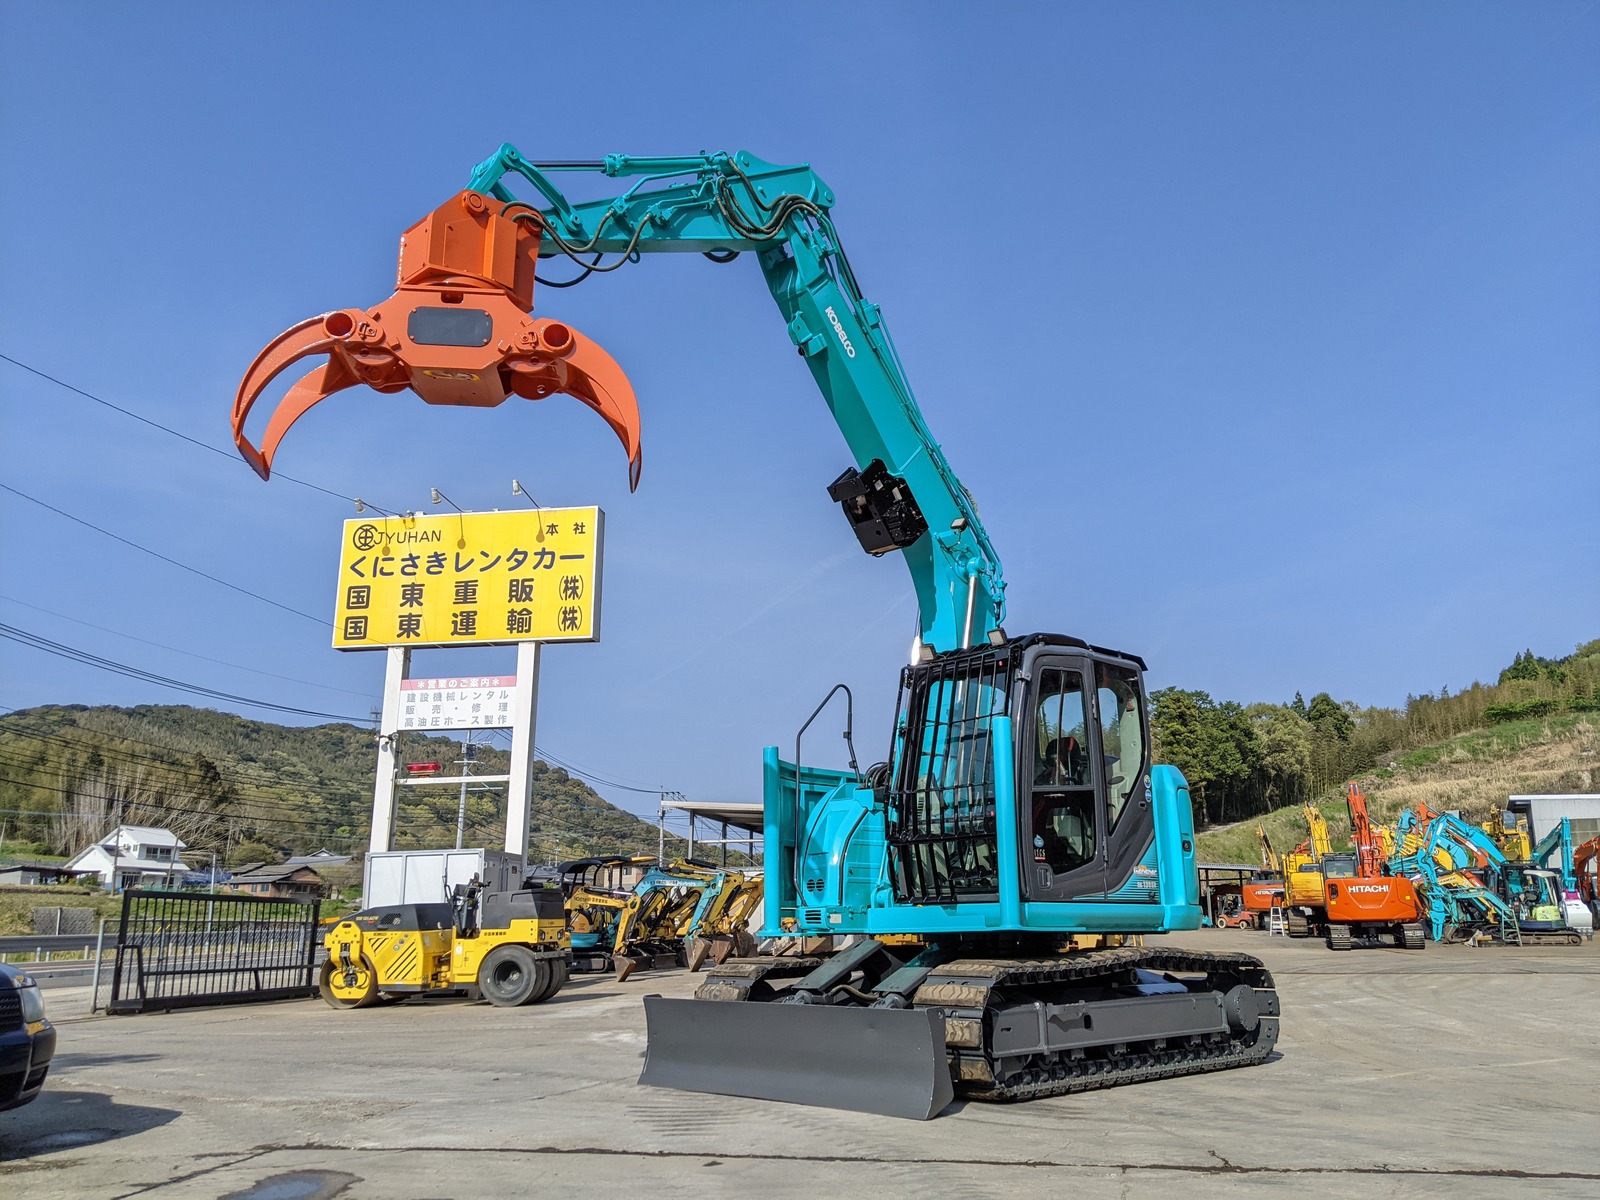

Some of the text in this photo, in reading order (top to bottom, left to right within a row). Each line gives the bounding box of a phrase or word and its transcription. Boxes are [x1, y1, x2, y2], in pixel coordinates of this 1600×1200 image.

[825, 306, 856, 359] KOBELCO
[374, 530, 442, 545] JYUHAN
[350, 547, 585, 578] くにさきレンタカー
[406, 690, 509, 703] 建設機械レンタル
[404, 714, 508, 727] 高油圧ホース製作
[1348, 884, 1389, 893] HITACHI
